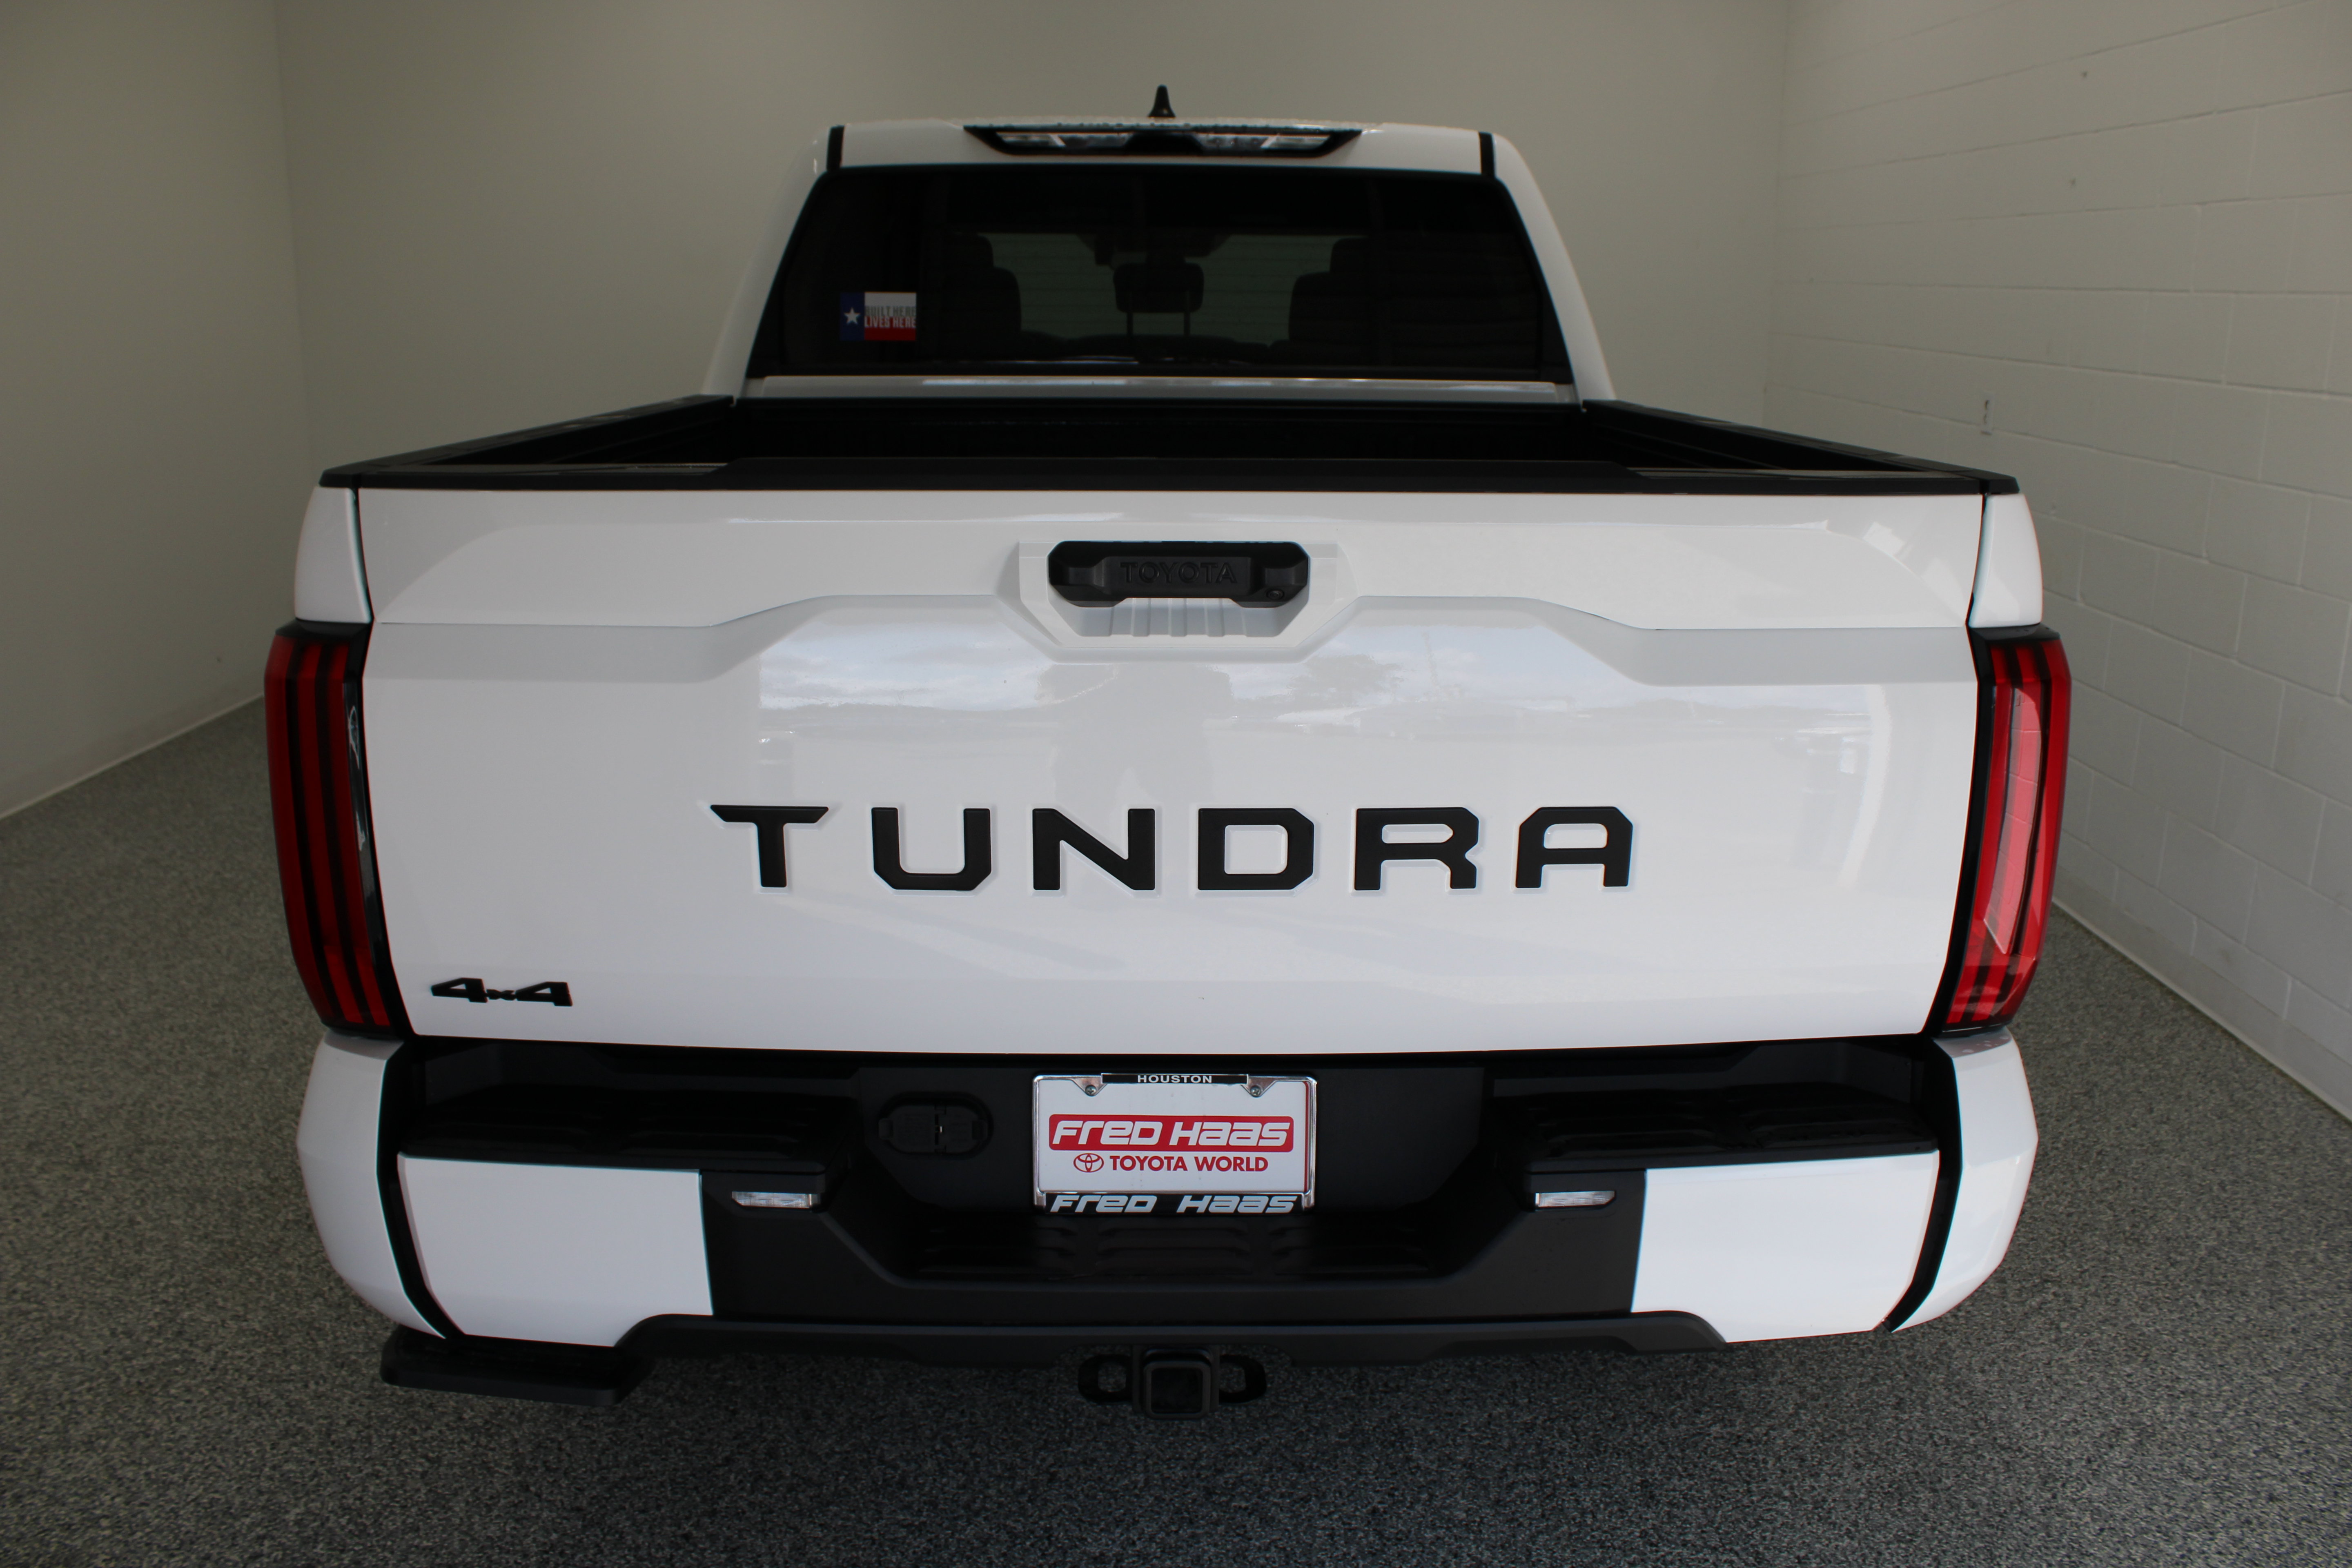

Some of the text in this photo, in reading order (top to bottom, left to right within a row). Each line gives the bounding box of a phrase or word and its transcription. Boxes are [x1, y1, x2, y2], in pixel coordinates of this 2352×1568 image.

[864, 316, 916, 328] LIVES HERE
[1120, 561, 1238, 584] TOYOTA
[709, 804, 1635, 892] TUNDRA
[1137, 1074, 1213, 1083] HOUSTON
[1109, 1155, 1269, 1172] TOYOTA WORLD
